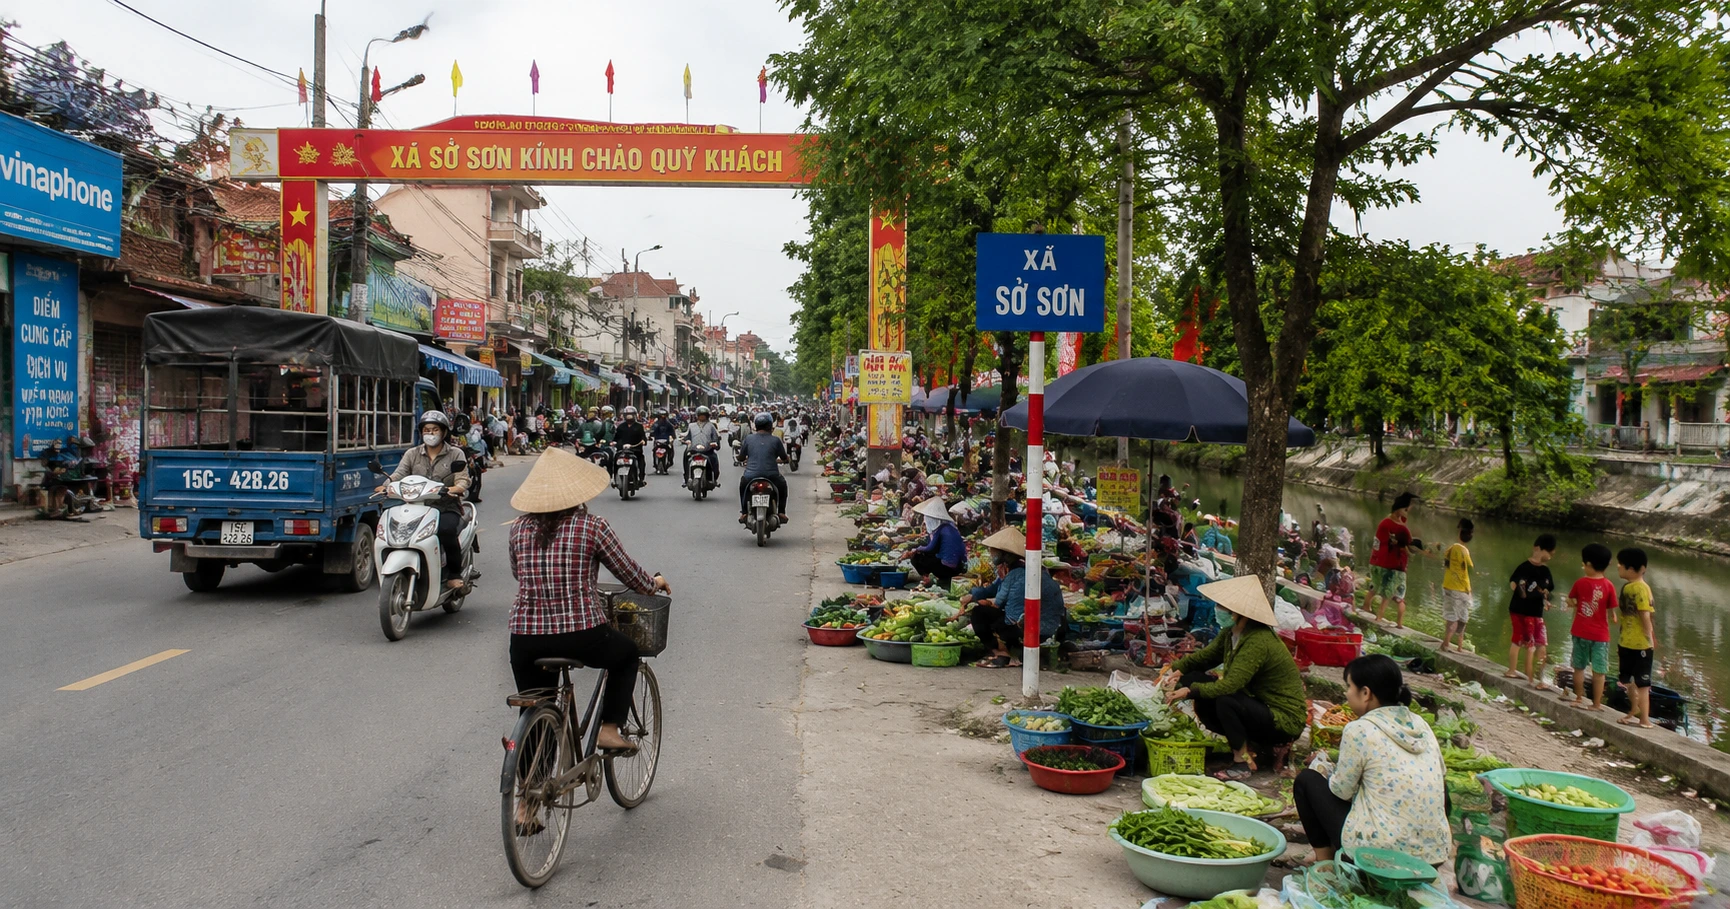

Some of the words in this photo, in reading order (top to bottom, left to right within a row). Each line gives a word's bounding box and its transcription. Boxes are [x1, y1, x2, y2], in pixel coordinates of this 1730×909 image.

[467, 144, 511, 170] SƠN
[705, 145, 782, 172] KHÁCH
[0, 150, 113, 212] vinaphone
[1023, 245, 1057, 271] XÃ
[995, 277, 1029, 316] SỞ
[1037, 284, 1085, 317] SƠN
[21, 323, 49, 345] CUNG
[183, 469, 221, 489] 15C-
[229, 470, 289, 490] 428.26
